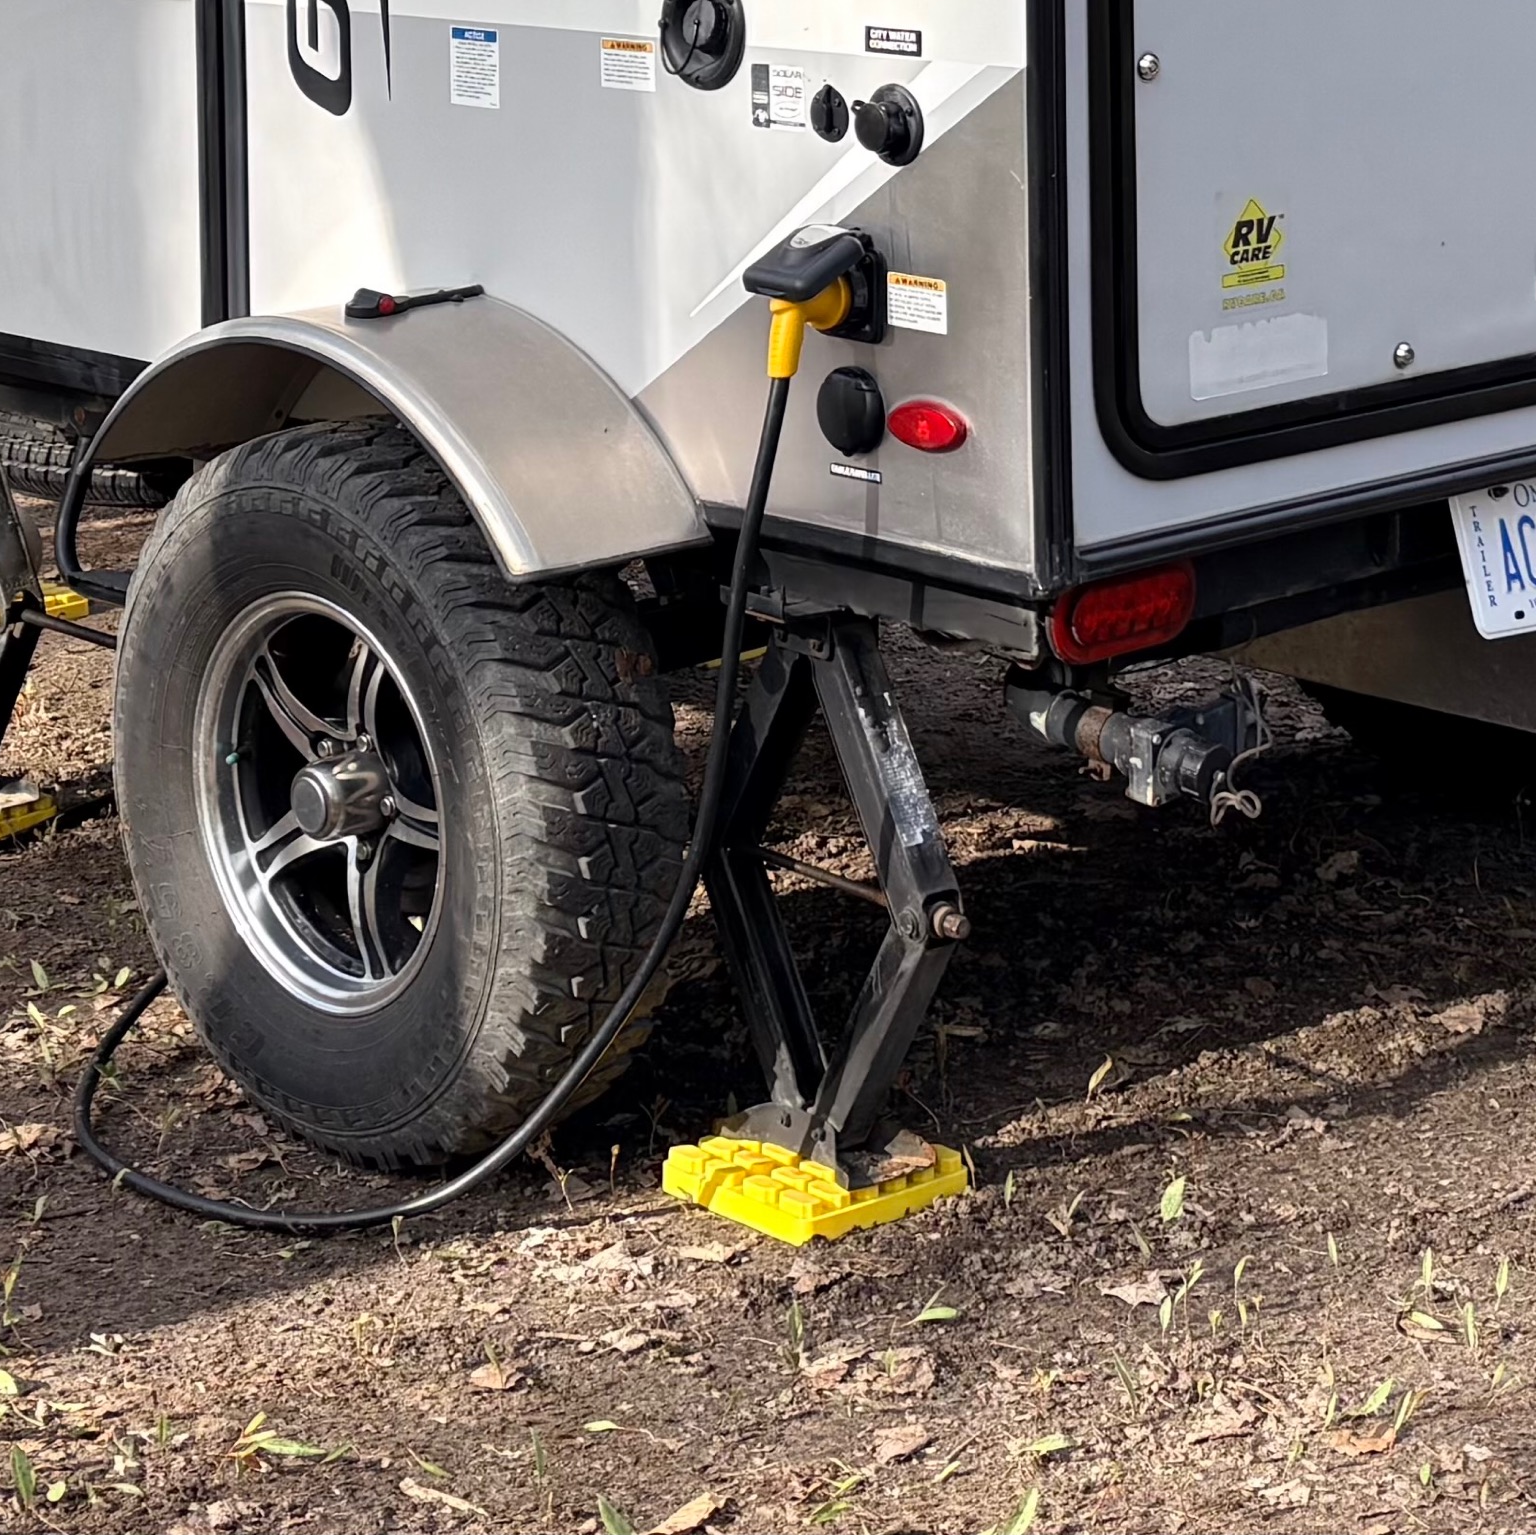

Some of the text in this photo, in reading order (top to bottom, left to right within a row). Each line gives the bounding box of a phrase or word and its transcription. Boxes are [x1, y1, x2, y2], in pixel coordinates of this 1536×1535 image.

[869, 28, 888, 41] CITY
[772, 69, 802, 80] SOLAR
[772, 84, 803, 99] SIDE
[1231, 215, 1277, 249] RV
[1229, 245, 1272, 266] CARE
[900, 277, 939, 290] WARNING
[1468, 505, 1498, 607] TRAILER
